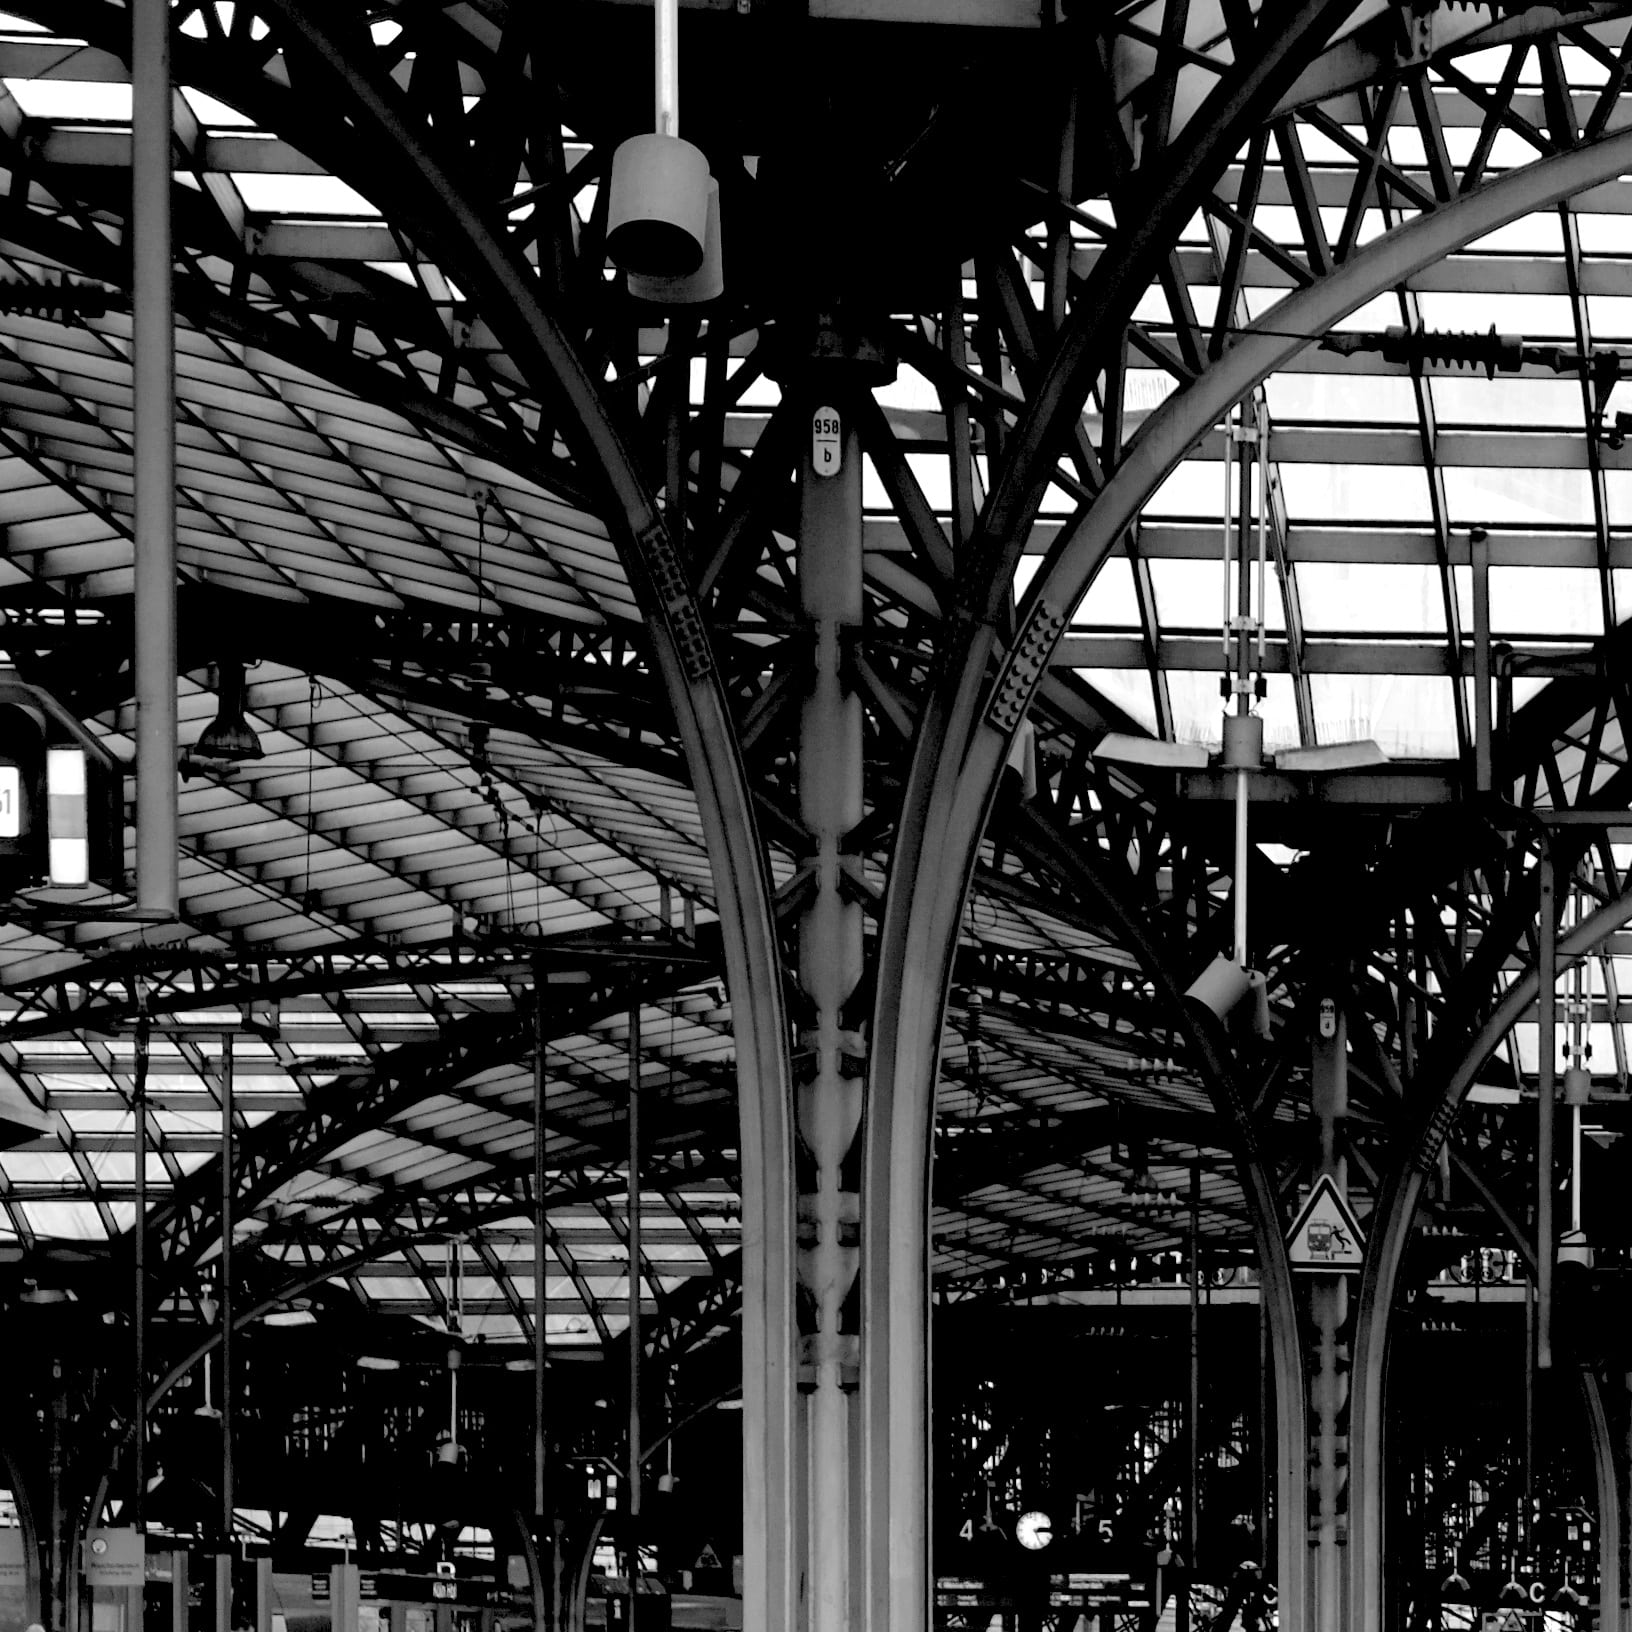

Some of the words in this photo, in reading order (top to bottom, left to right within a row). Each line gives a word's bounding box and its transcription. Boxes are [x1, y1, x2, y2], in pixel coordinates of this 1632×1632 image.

[815, 419, 839, 434] 958
[824, 447, 832, 462] b
[960, 1519, 973, 1541] 4
[1099, 1520, 1113, 1542] 5
[1529, 1582, 1545, 1603] C
